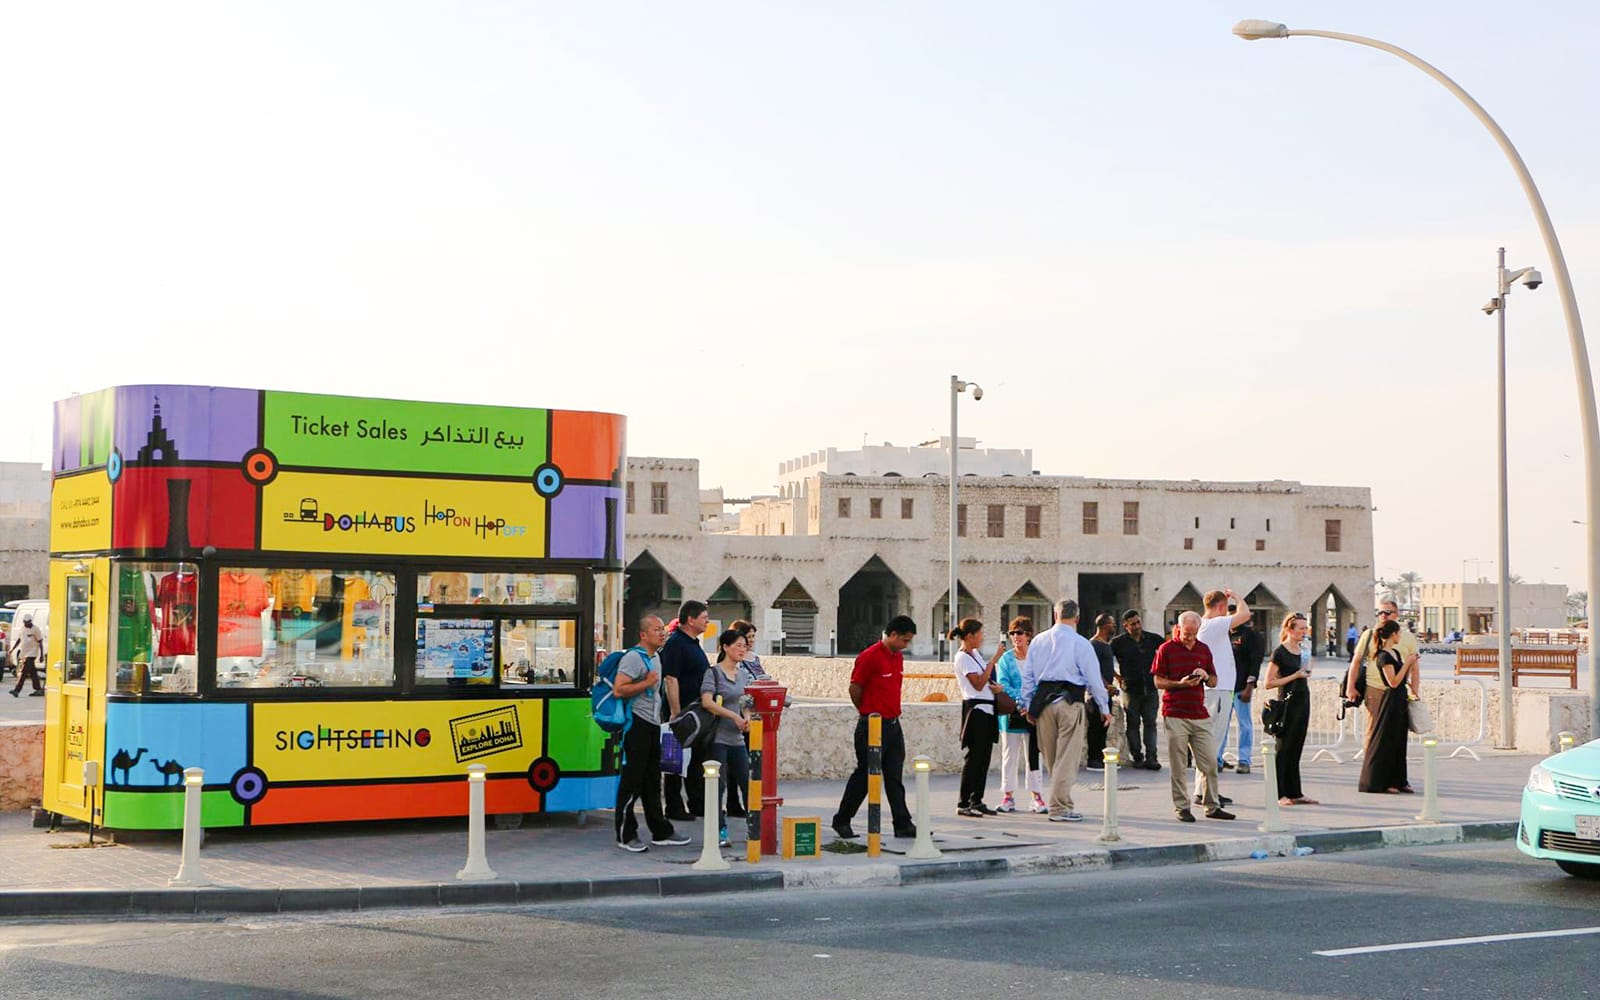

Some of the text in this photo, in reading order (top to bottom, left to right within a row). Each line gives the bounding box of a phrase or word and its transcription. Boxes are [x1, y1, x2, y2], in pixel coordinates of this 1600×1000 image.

[291, 415, 408, 441] Ticket Sales
[420, 425, 524, 449] بيع التذاكر
[453, 516, 471, 527] ON
[503, 526, 527, 537] OFF
[275, 724, 431, 752] SIGHTSEEING
[461, 734, 514, 753] EXPLORE DOHA
